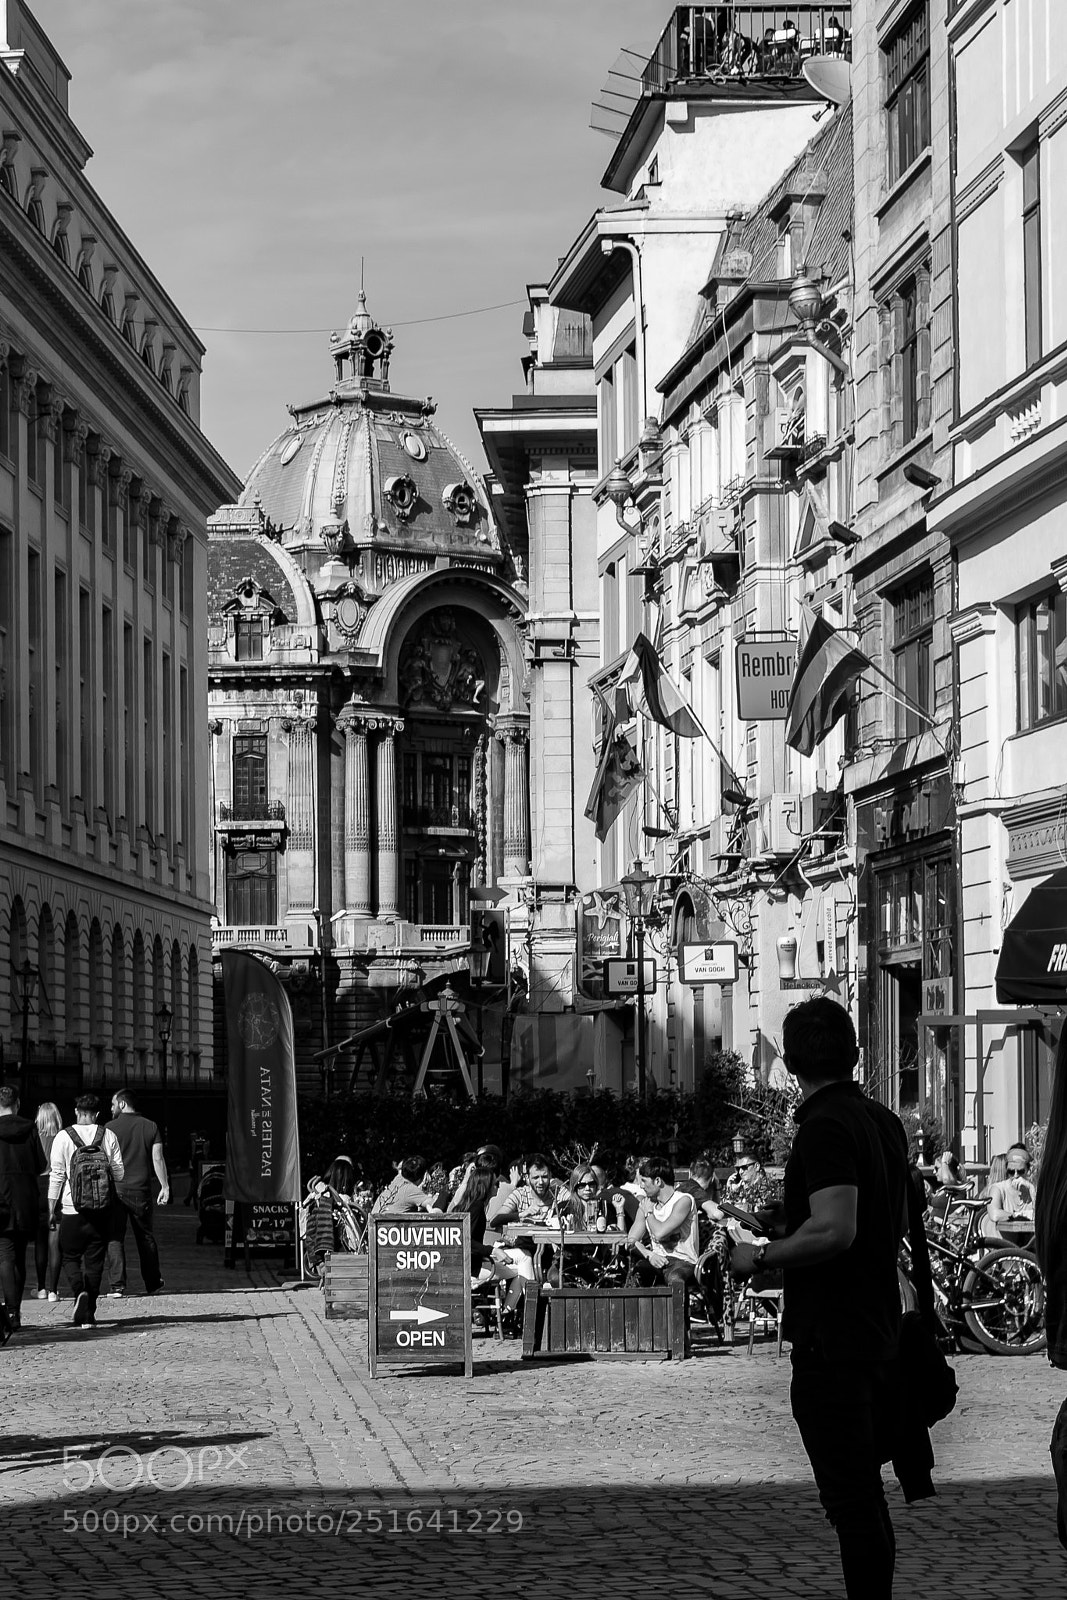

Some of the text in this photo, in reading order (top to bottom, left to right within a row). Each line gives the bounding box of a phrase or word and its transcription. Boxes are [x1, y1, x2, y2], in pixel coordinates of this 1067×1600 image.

[783, 982, 821, 990] Heineken
[252, 1205, 289, 1214] SNACKS
[377, 1226, 461, 1246] SOUVENIR
[396, 1251, 441, 1270] SHOP
[396, 1330, 445, 1347] OPEN
